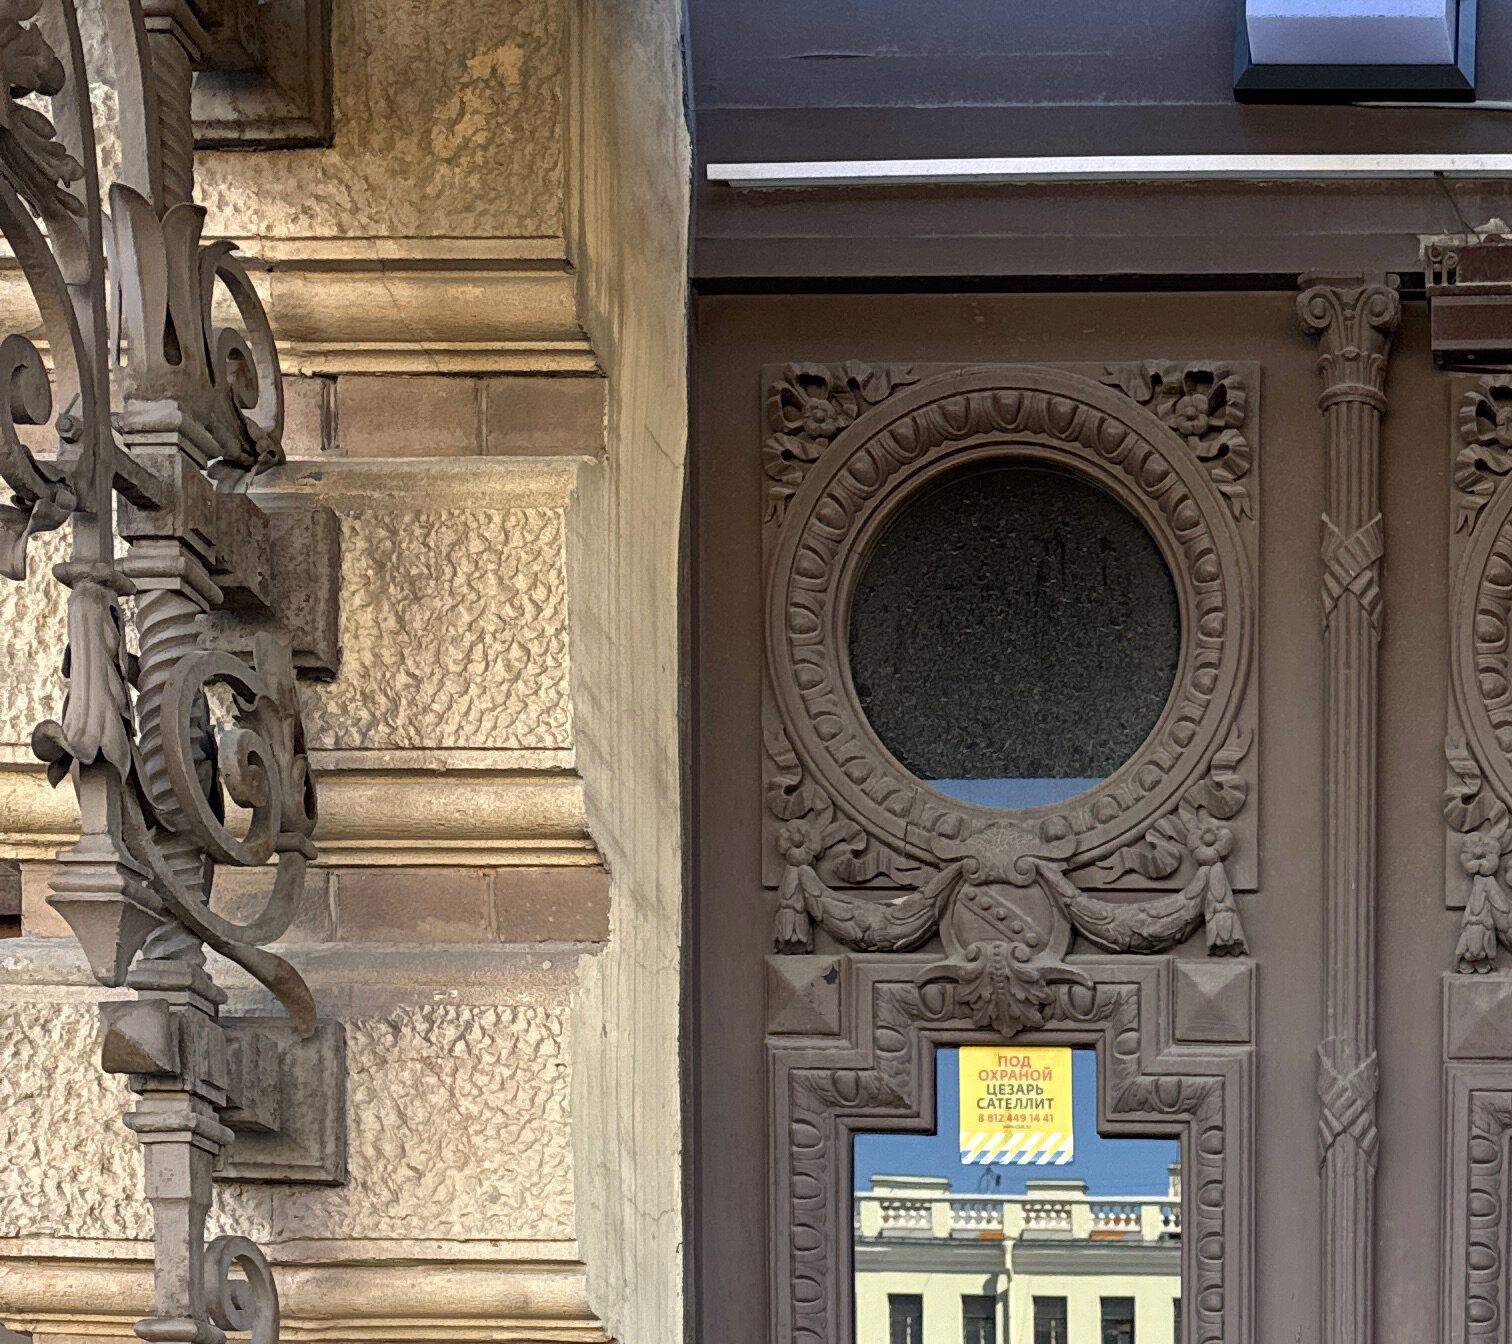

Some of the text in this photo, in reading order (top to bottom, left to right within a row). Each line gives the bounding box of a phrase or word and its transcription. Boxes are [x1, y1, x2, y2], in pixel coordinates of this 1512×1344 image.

[998, 1055, 1032, 1069] ПОД
[978, 1066, 1053, 1081] ОХРАНОЙ
[986, 1083, 1044, 1097] ЦЕЗАРЬ
[976, 1097, 1055, 1110] САТЕЛЛИТ
[978, 1113, 1054, 1123] 8 812 449 14 41
